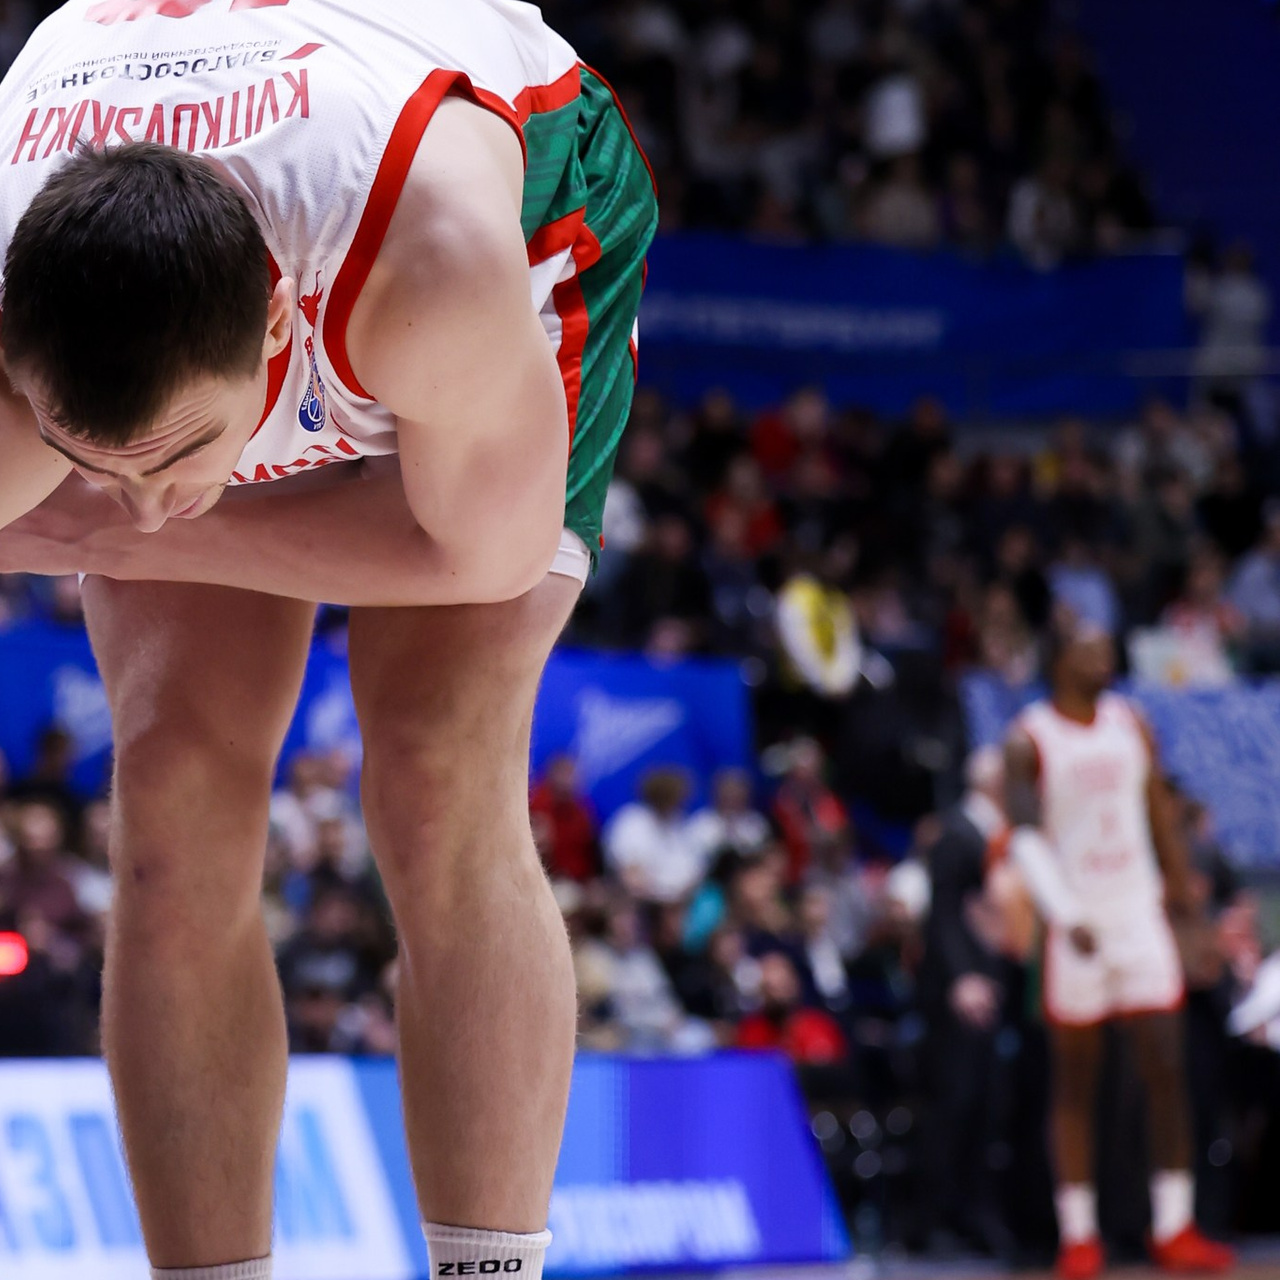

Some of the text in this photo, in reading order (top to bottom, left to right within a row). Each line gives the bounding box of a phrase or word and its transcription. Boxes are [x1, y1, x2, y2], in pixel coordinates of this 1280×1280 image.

[25, 49, 279, 104] БЛАГОСОСТОЯНИЕ
[10, 67, 311, 166] KVITKOVSKIKH
[437, 1258, 523, 1277] ZEDO
